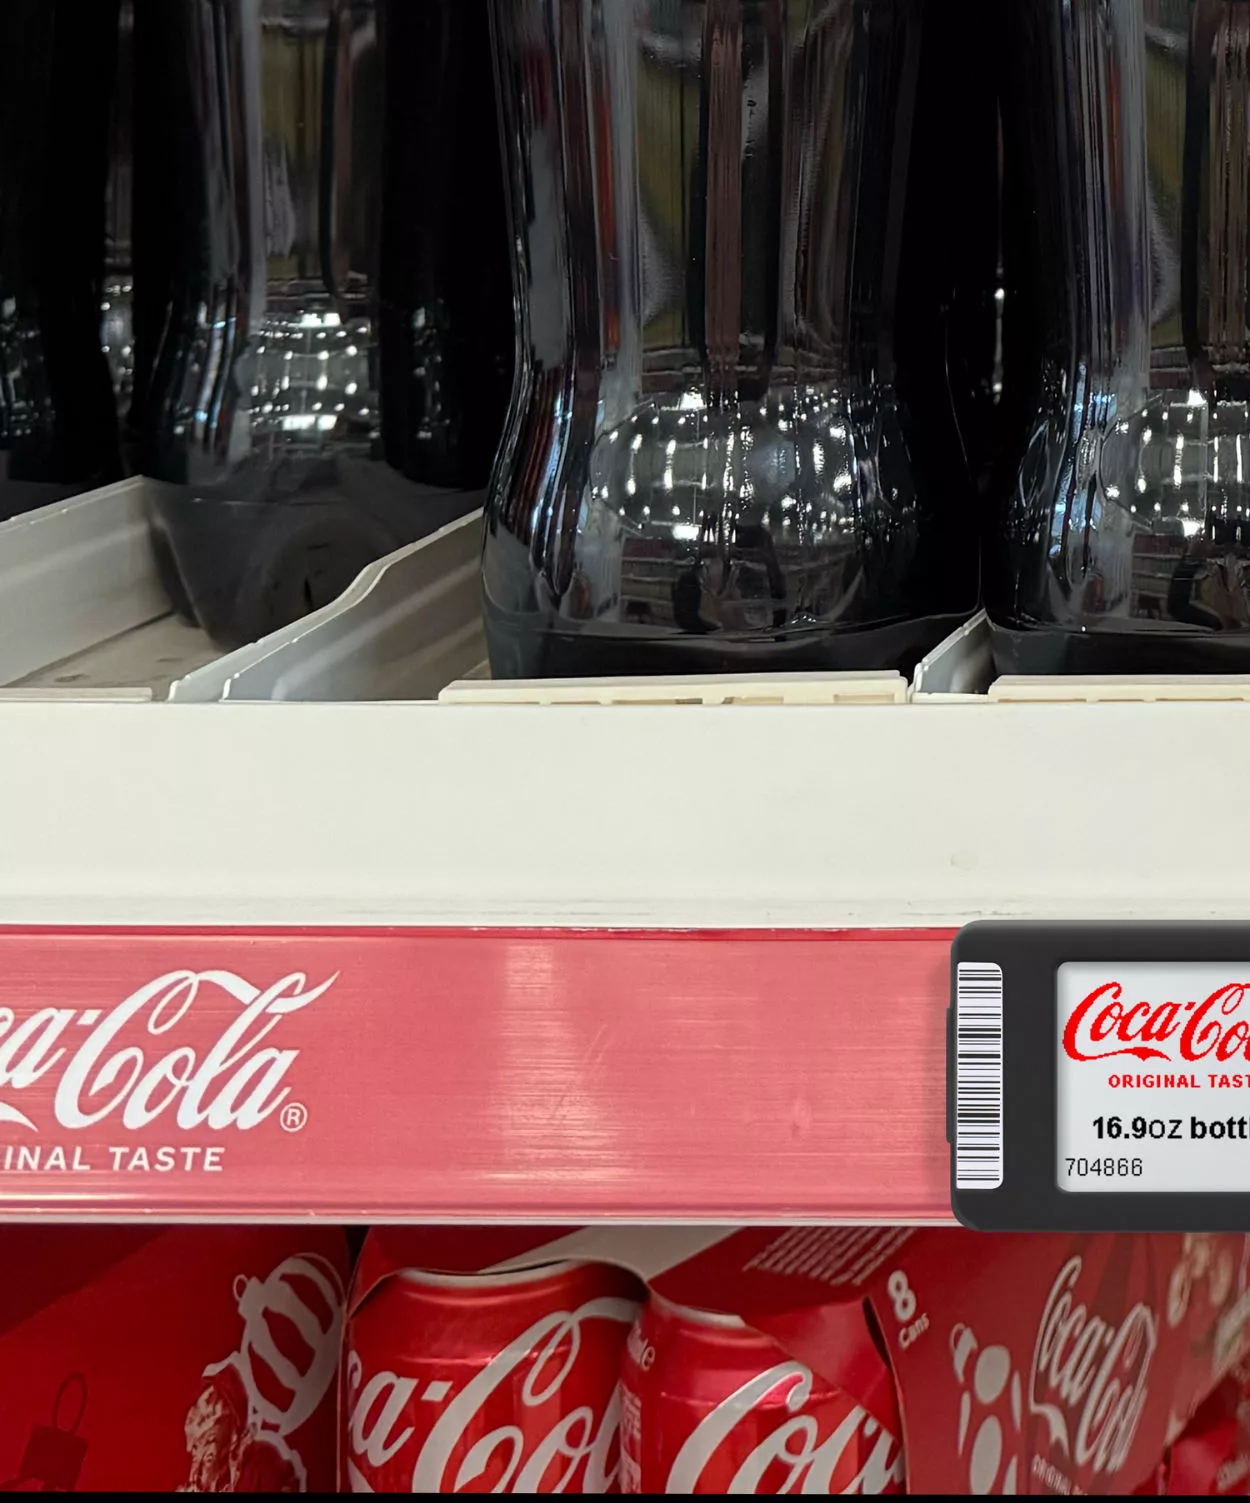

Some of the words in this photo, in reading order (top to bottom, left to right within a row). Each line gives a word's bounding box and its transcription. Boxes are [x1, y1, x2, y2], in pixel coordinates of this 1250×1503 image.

[1107, 1073, 1201, 1089] ORIGINAL
[108, 1146, 225, 1172] TASTE
[1065, 1157, 1143, 1177] 704866
[887, 1270, 917, 1322] 8
[898, 1312, 930, 1350] Cans
